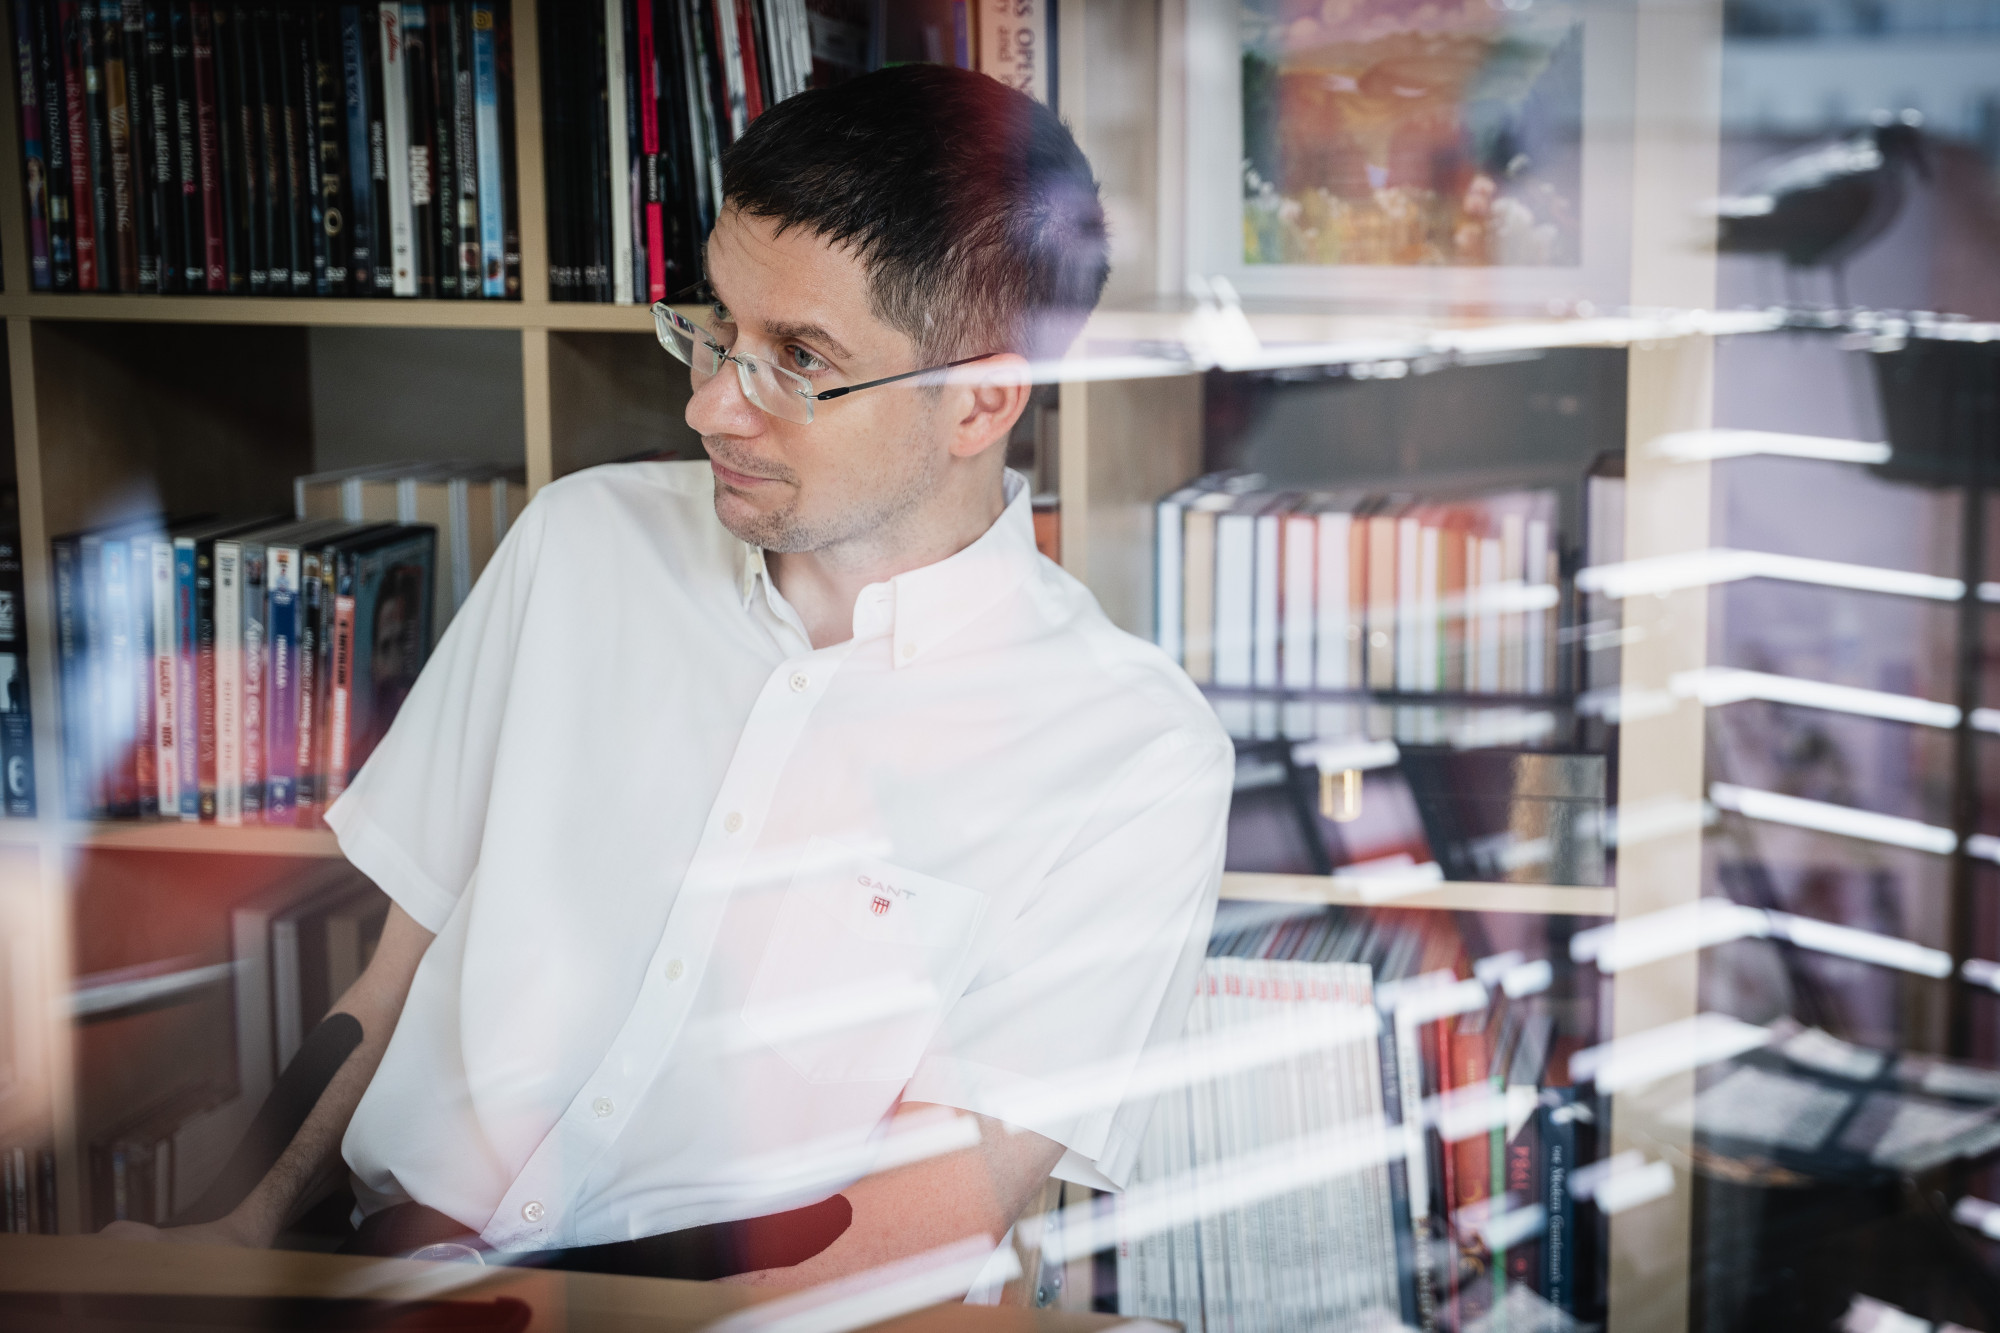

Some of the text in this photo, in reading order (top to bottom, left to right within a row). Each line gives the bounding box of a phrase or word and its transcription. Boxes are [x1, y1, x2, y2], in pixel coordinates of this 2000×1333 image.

[997, 26, 1016, 62] and
[408, 145, 431, 207] DOGMA
[243, 617, 265, 693] Lovely
[244, 694, 262, 727] So
[857, 875, 917, 900] GANT
[1510, 1146, 1531, 1190] 1984
[1550, 1166, 1566, 1213] Modern
[1549, 1215, 1565, 1283] Gentleman's
